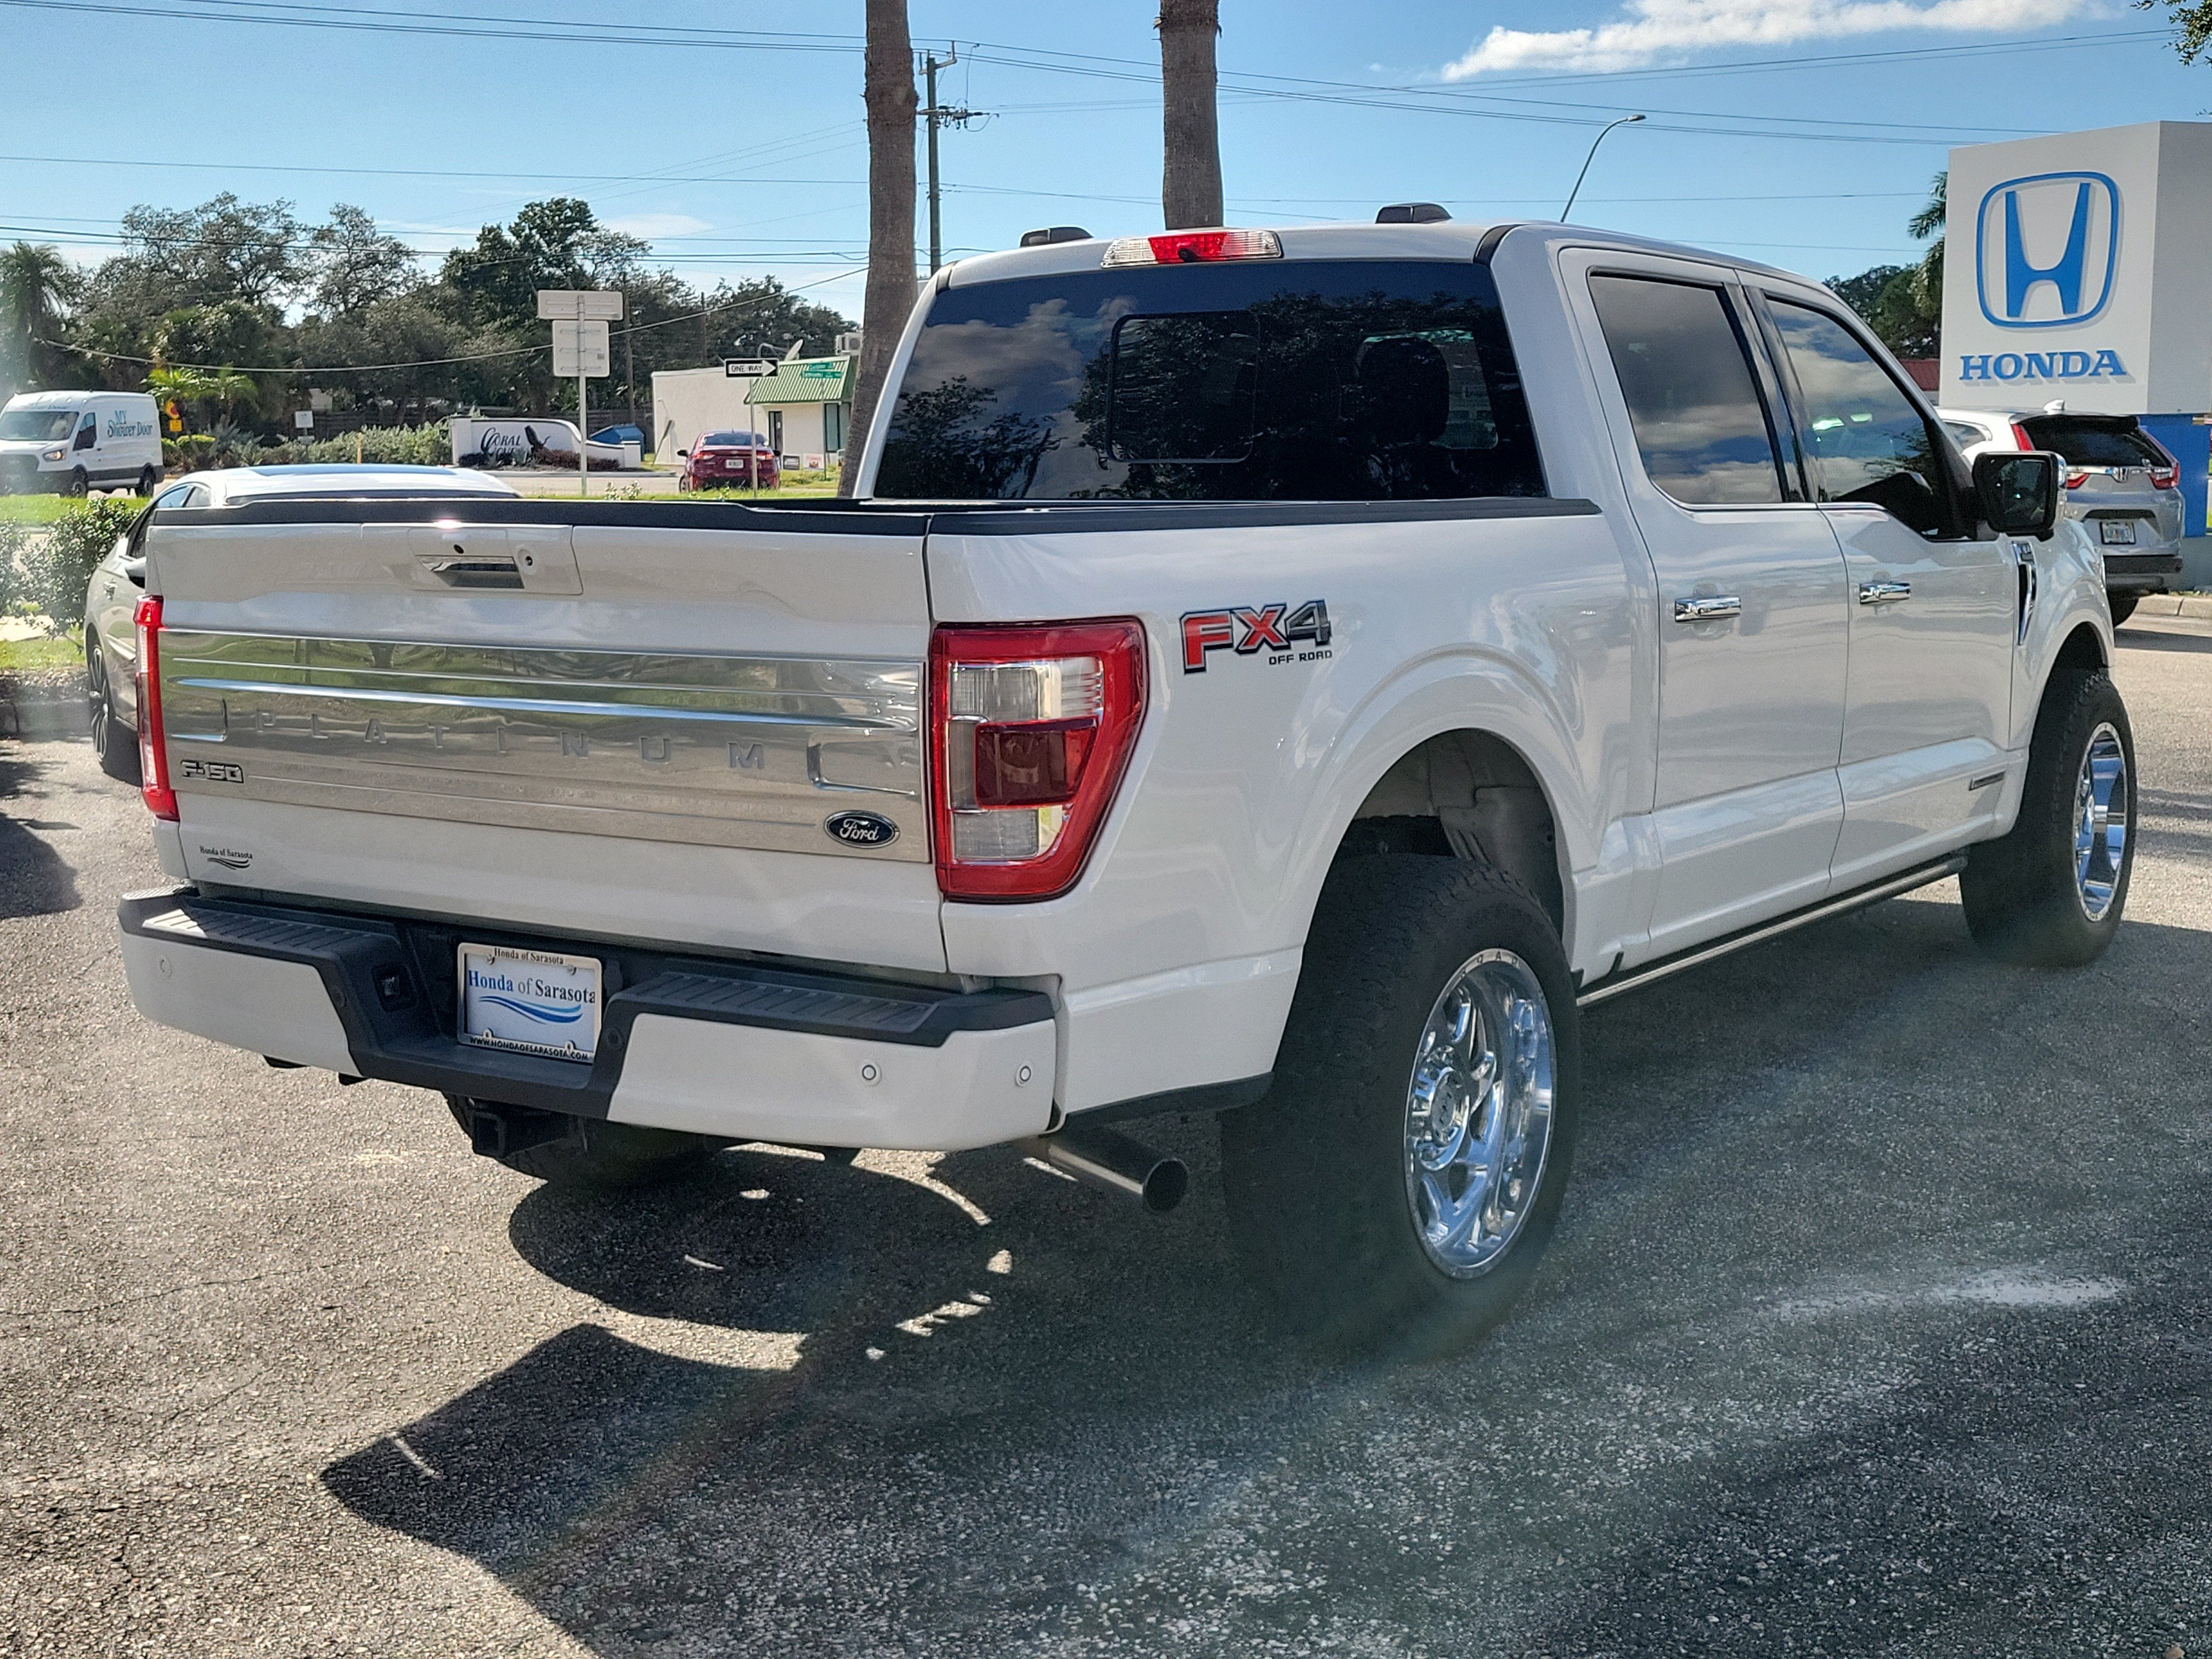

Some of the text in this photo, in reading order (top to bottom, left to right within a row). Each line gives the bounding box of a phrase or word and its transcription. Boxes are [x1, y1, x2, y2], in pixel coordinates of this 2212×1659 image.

[1959, 349, 2127, 382] HONDA
[481, 427, 521, 452] CORAL
[1179, 599, 1332, 675] FX4
[1269, 650, 1333, 665] OFF ROAD
[256, 709, 765, 770] PLATINUM
[180, 759, 244, 783] F-150
[839, 818, 880, 841] Ford
[199, 845, 253, 859] Honda of Sarasota
[494, 947, 564, 965] Honda of Sarasota
[468, 970, 596, 1004] Honda of Sarasota
[469, 1036, 589, 1060] WWW.HONDAOFSARASOTA.COM
